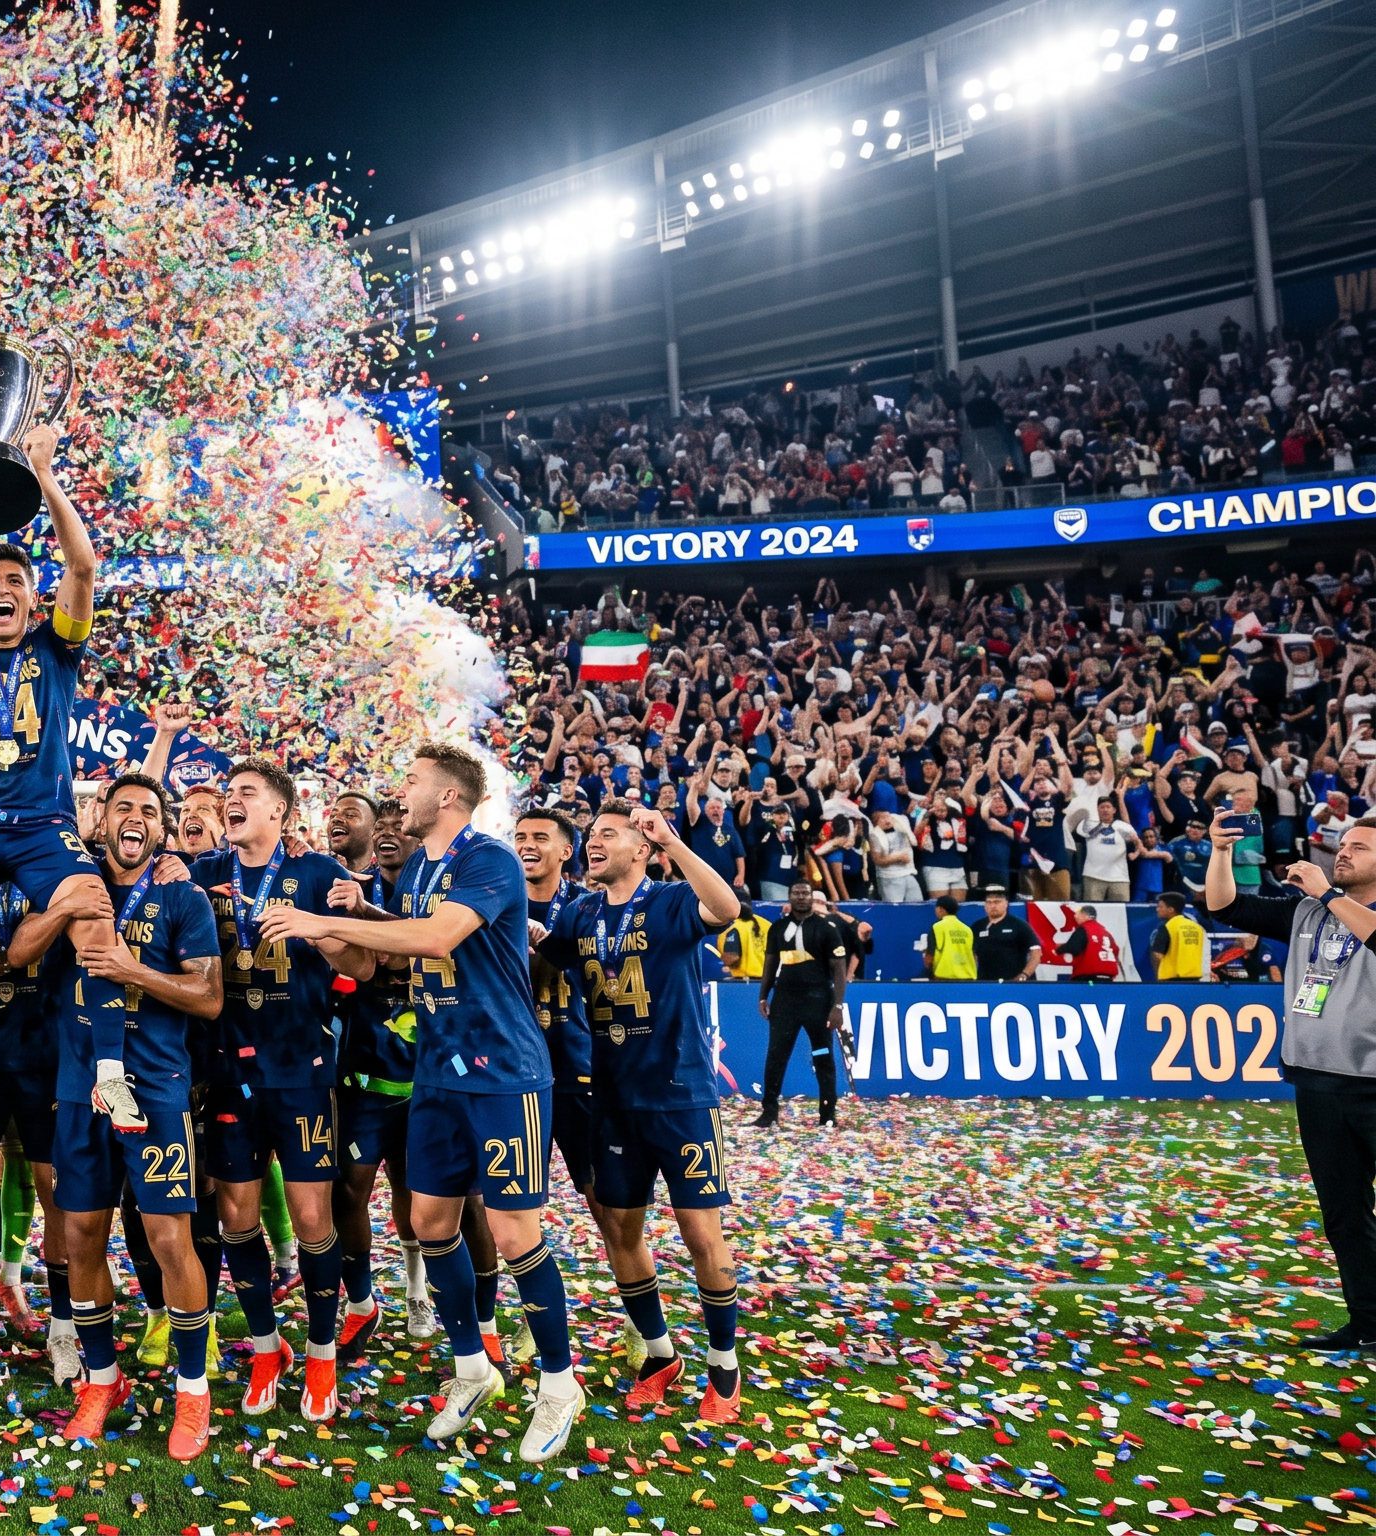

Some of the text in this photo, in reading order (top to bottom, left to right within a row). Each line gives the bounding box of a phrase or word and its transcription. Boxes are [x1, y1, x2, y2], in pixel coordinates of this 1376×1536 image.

[586, 524, 859, 563] VICTORY 2024
[584, 955, 652, 1021] 24
[842, 1001, 1285, 1083] VICTORY 202
[295, 1115, 333, 1153] 14
[141, 1143, 189, 1183] 22
[484, 1137, 525, 1178] 21
[680, 1140, 719, 1179] 21
